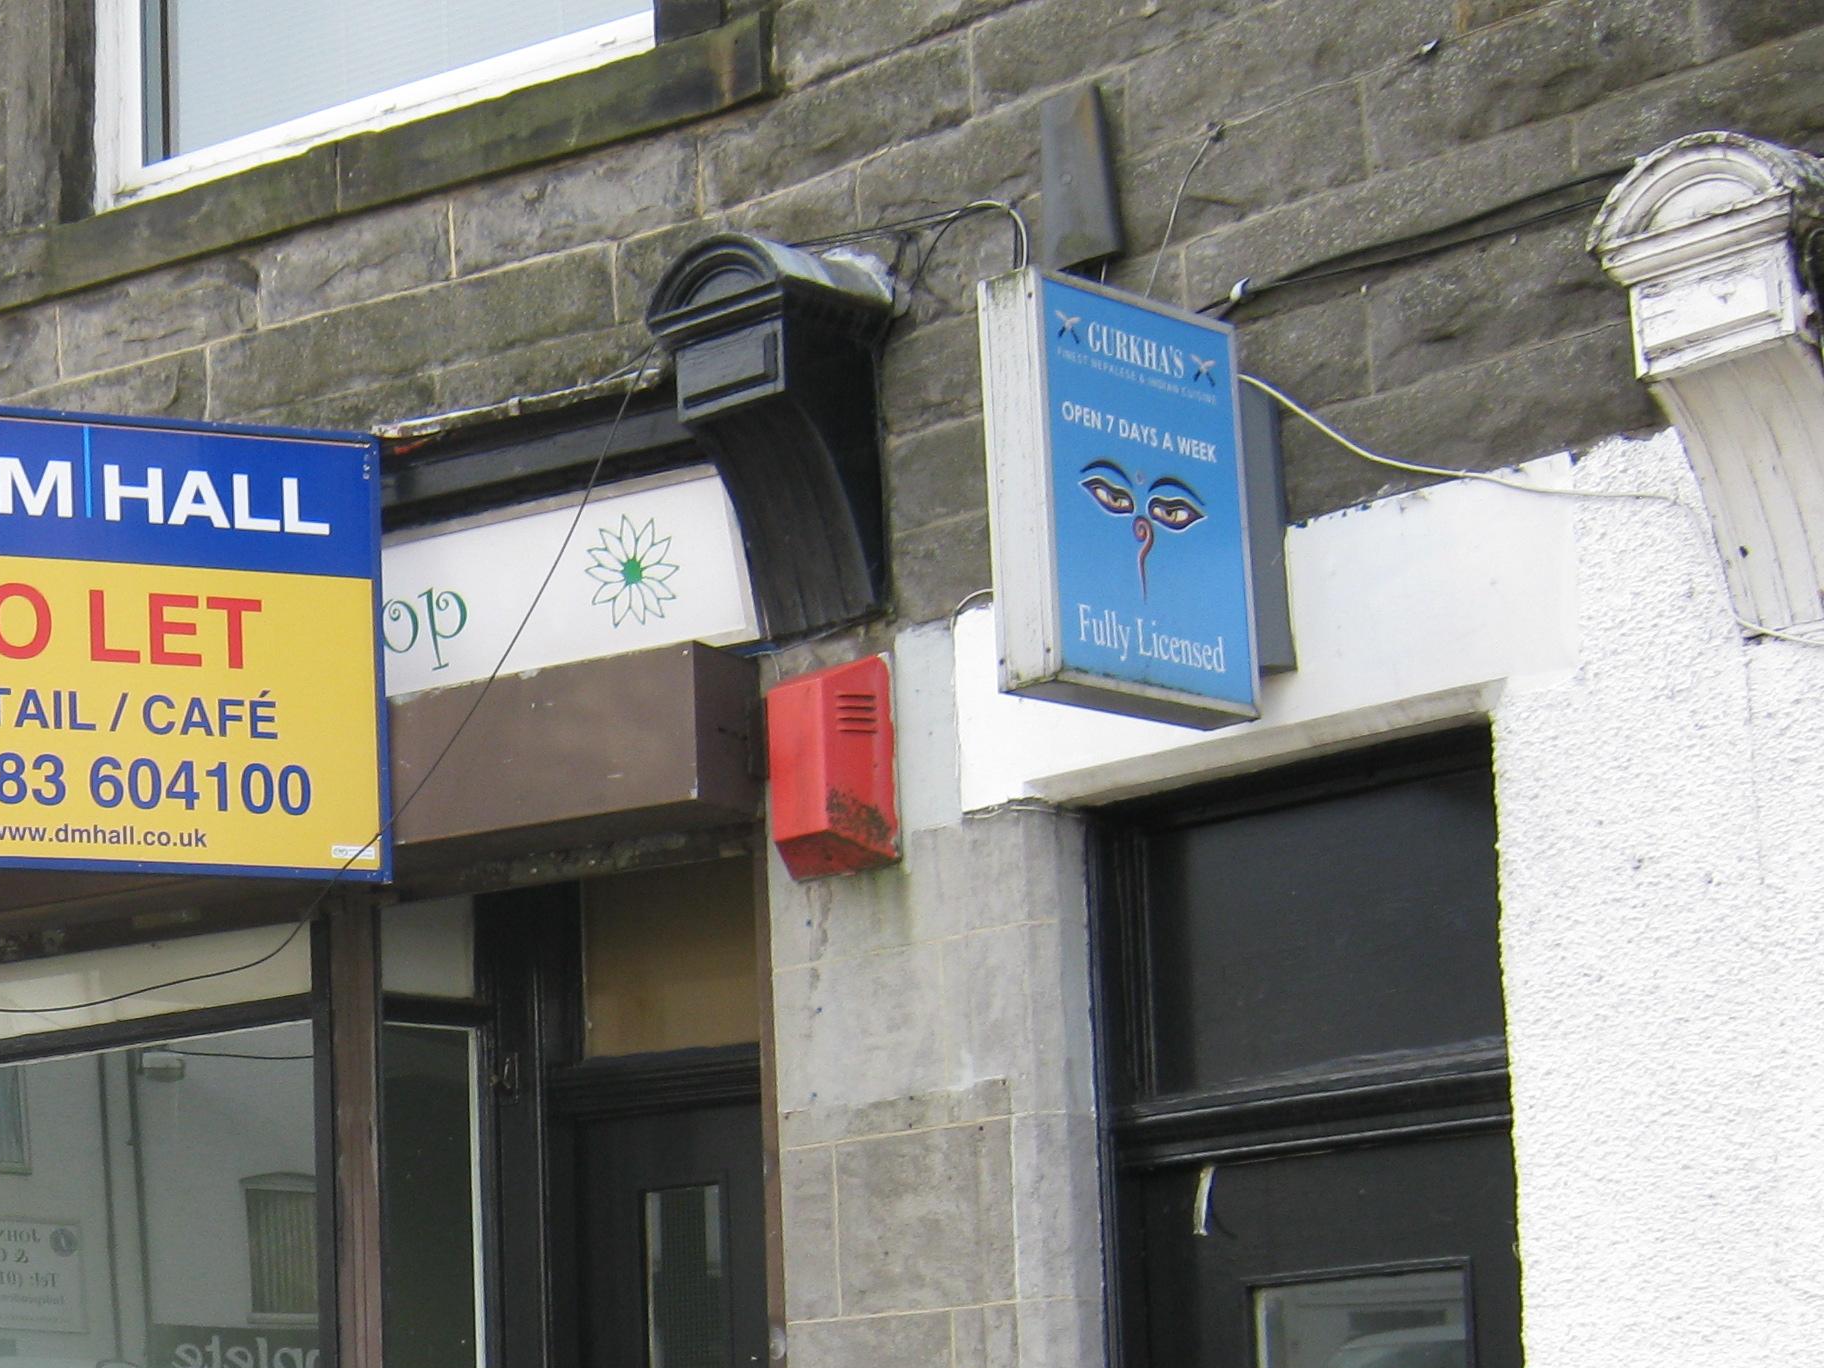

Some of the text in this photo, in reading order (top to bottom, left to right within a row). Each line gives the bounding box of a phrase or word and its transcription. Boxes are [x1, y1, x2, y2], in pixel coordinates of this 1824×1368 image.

[1087, 320, 1185, 378] GURKHA'S
[1062, 400, 1217, 464] OPEN 7 DAYS A WEEK
[104, 466, 330, 536] HALL
[90, 590, 263, 670] LET
[1077, 603, 1226, 673] Fully Licensed
[142, 689, 279, 741] CAFÉ
[89, 757, 313, 816] 604100
